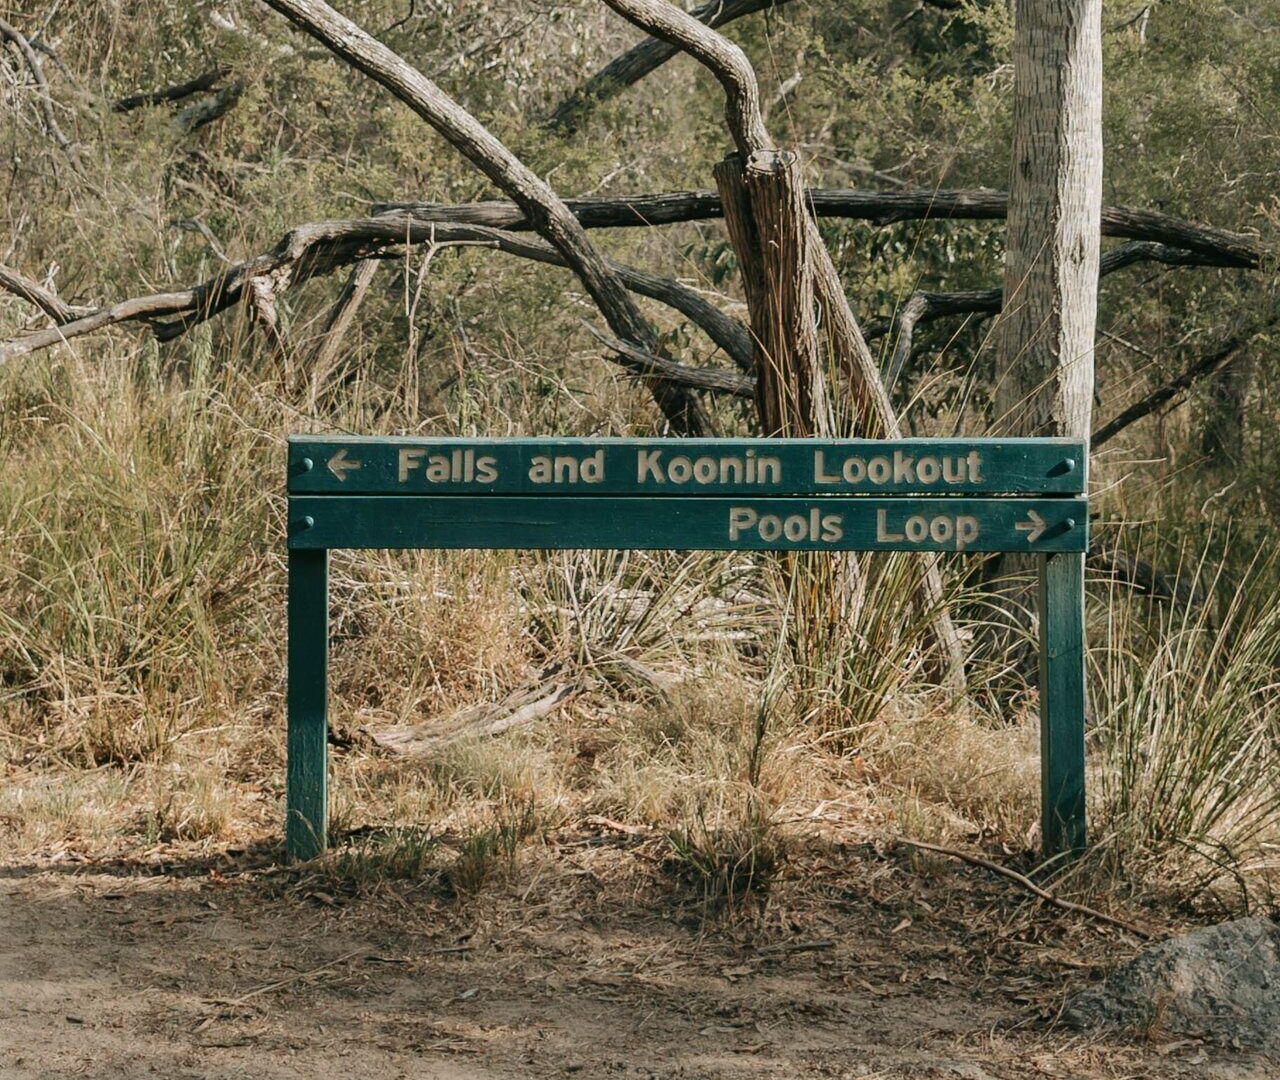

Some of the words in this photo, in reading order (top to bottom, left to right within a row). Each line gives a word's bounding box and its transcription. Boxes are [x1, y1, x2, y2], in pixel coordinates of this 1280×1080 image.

[398, 448, 498, 483] Falls
[528, 448, 605, 484] and
[637, 449, 782, 484] Koonin
[814, 449, 983, 484] Lookout
[729, 507, 843, 542] Pools
[877, 508, 979, 550] Loop
